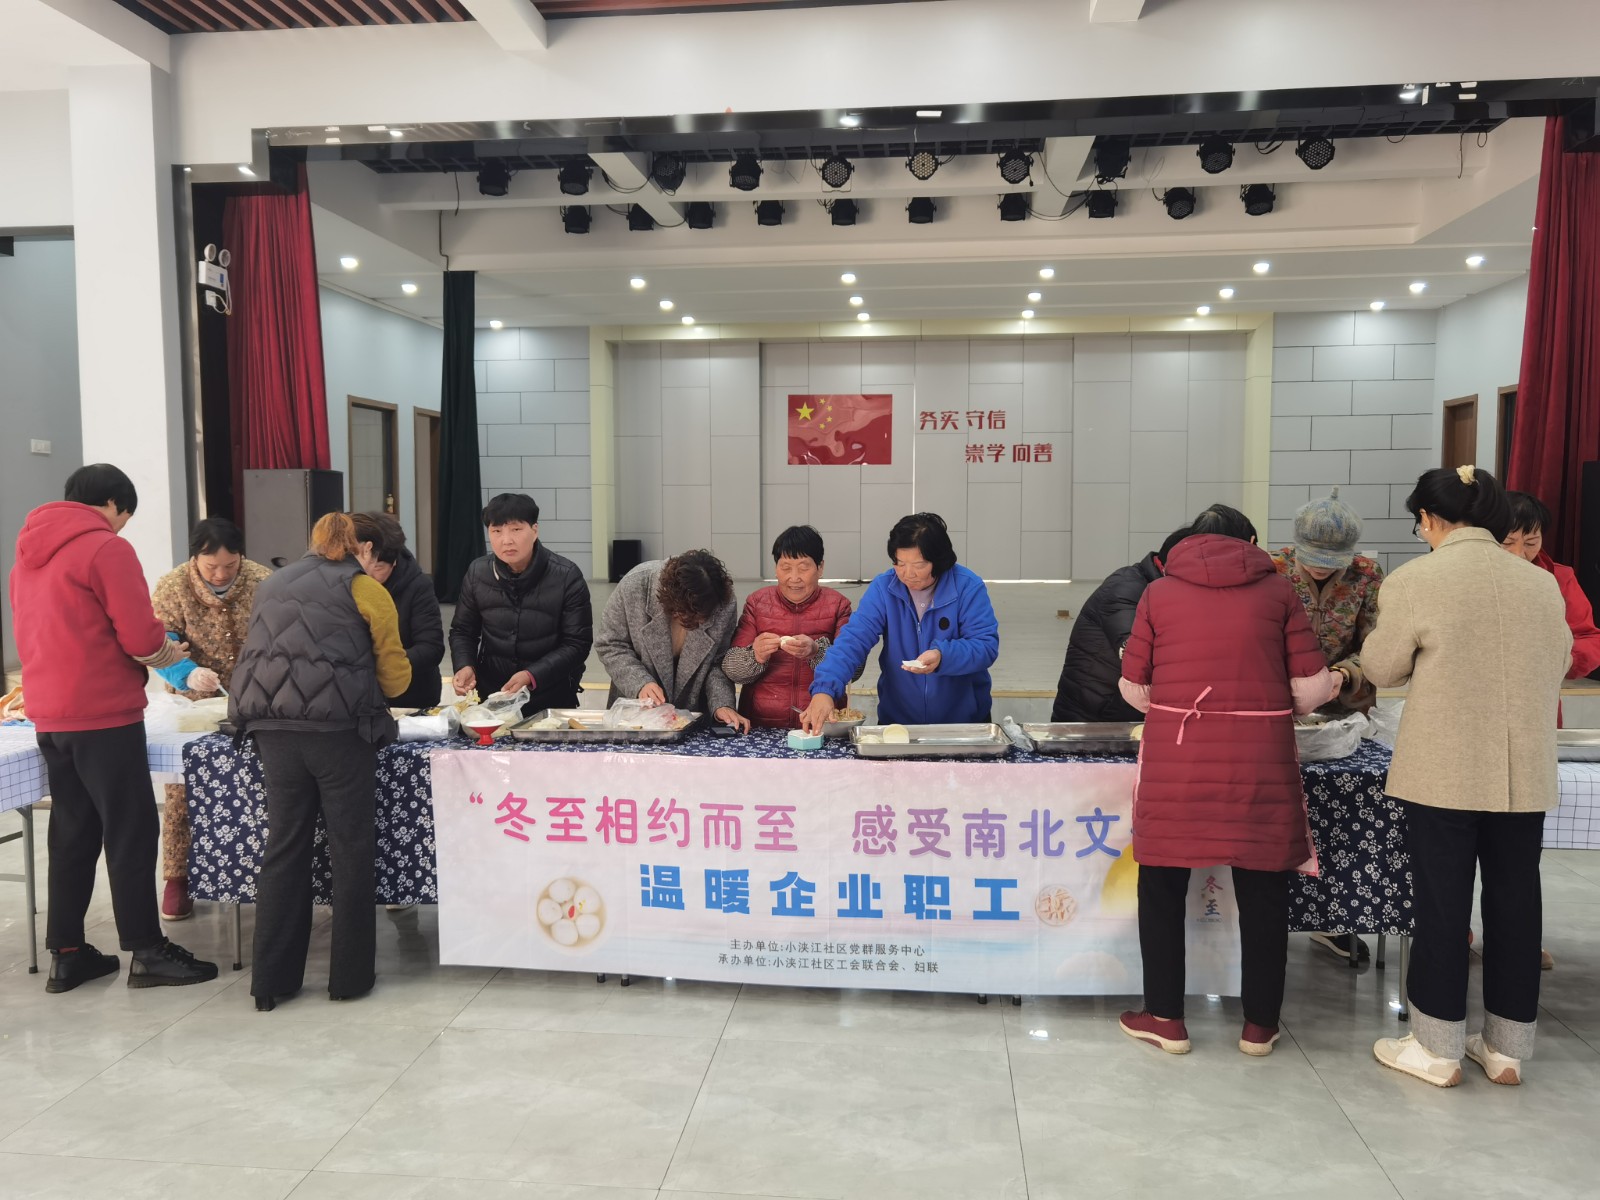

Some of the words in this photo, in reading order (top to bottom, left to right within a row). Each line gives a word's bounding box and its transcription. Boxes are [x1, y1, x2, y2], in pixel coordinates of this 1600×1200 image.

[852, 804, 1134, 858] 感受南北文
[640, 864, 1020, 920] 温暖企业职工
[1201, 875, 1223, 916] 冬至
